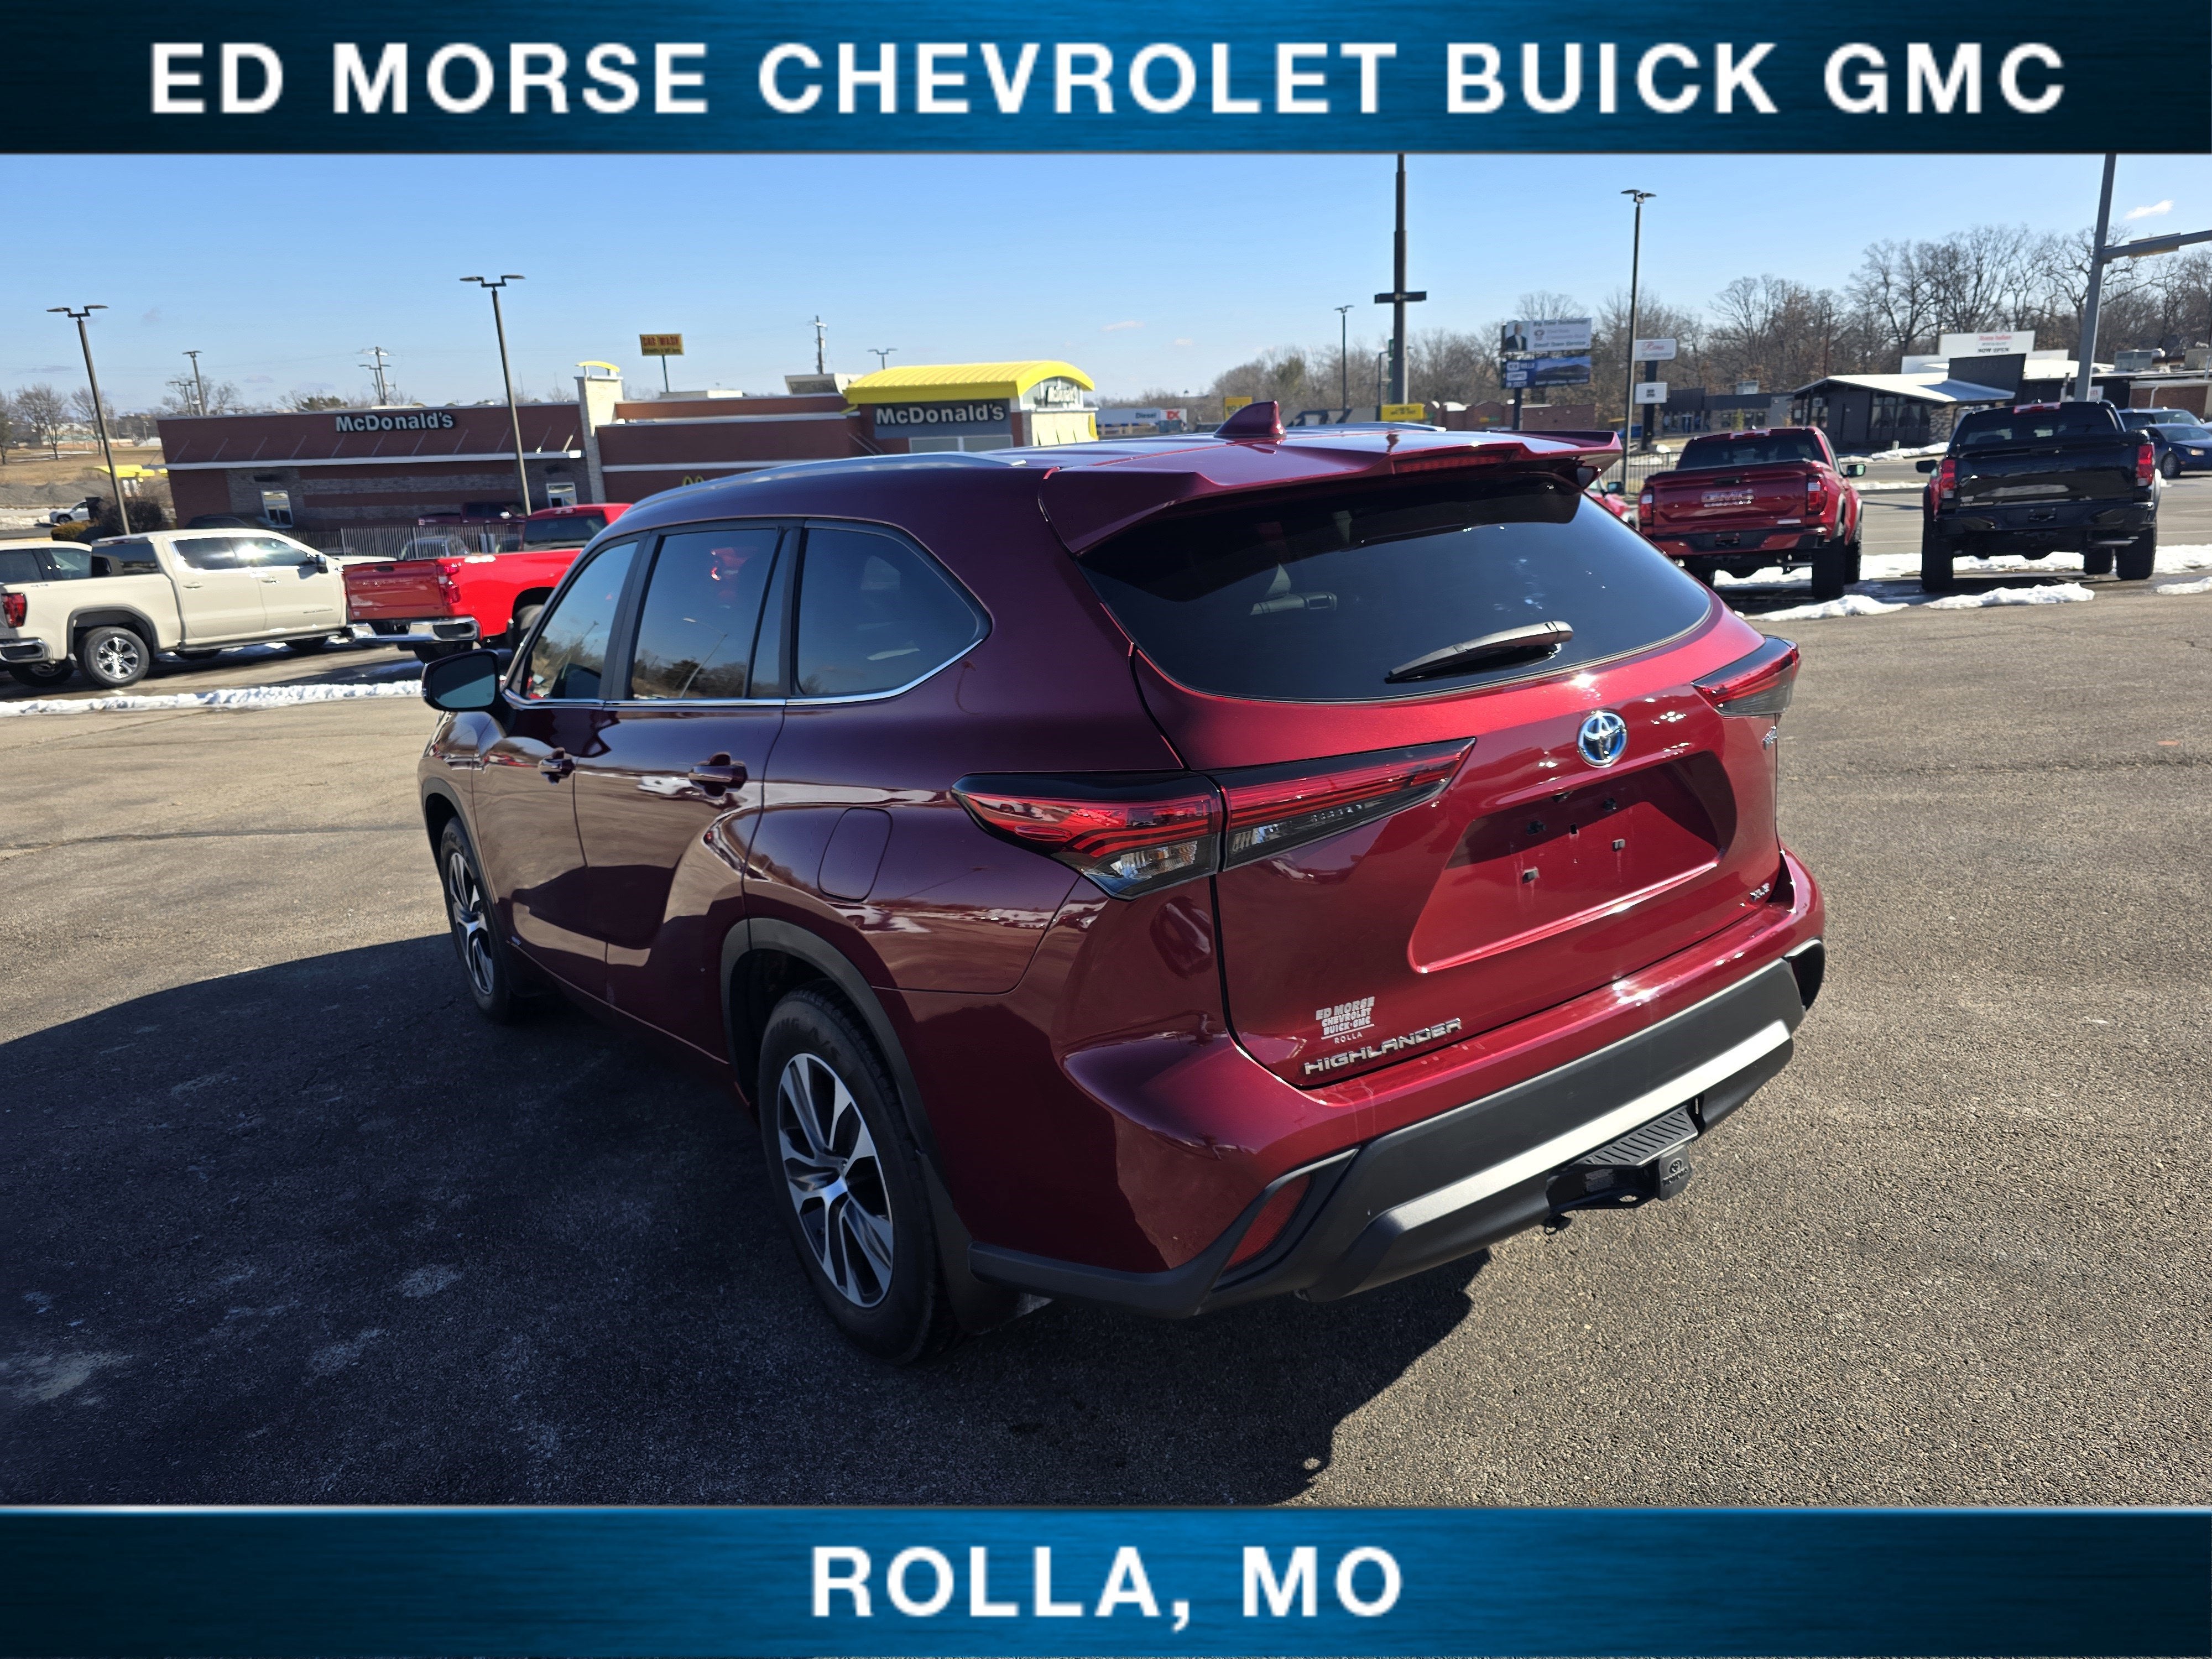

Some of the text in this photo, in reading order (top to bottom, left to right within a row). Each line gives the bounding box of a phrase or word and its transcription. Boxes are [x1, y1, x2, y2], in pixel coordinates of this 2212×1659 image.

[335, 412, 454, 432] McDonald's
[875, 404, 1005, 424] McDonald's
[1316, 996, 1375, 1020] ED MORSE
[1322, 1007, 1371, 1027] CHEVROLET
[1304, 1017, 1463, 1075] HIGHLANDER
[1334, 1031, 1363, 1044] ROLLA
